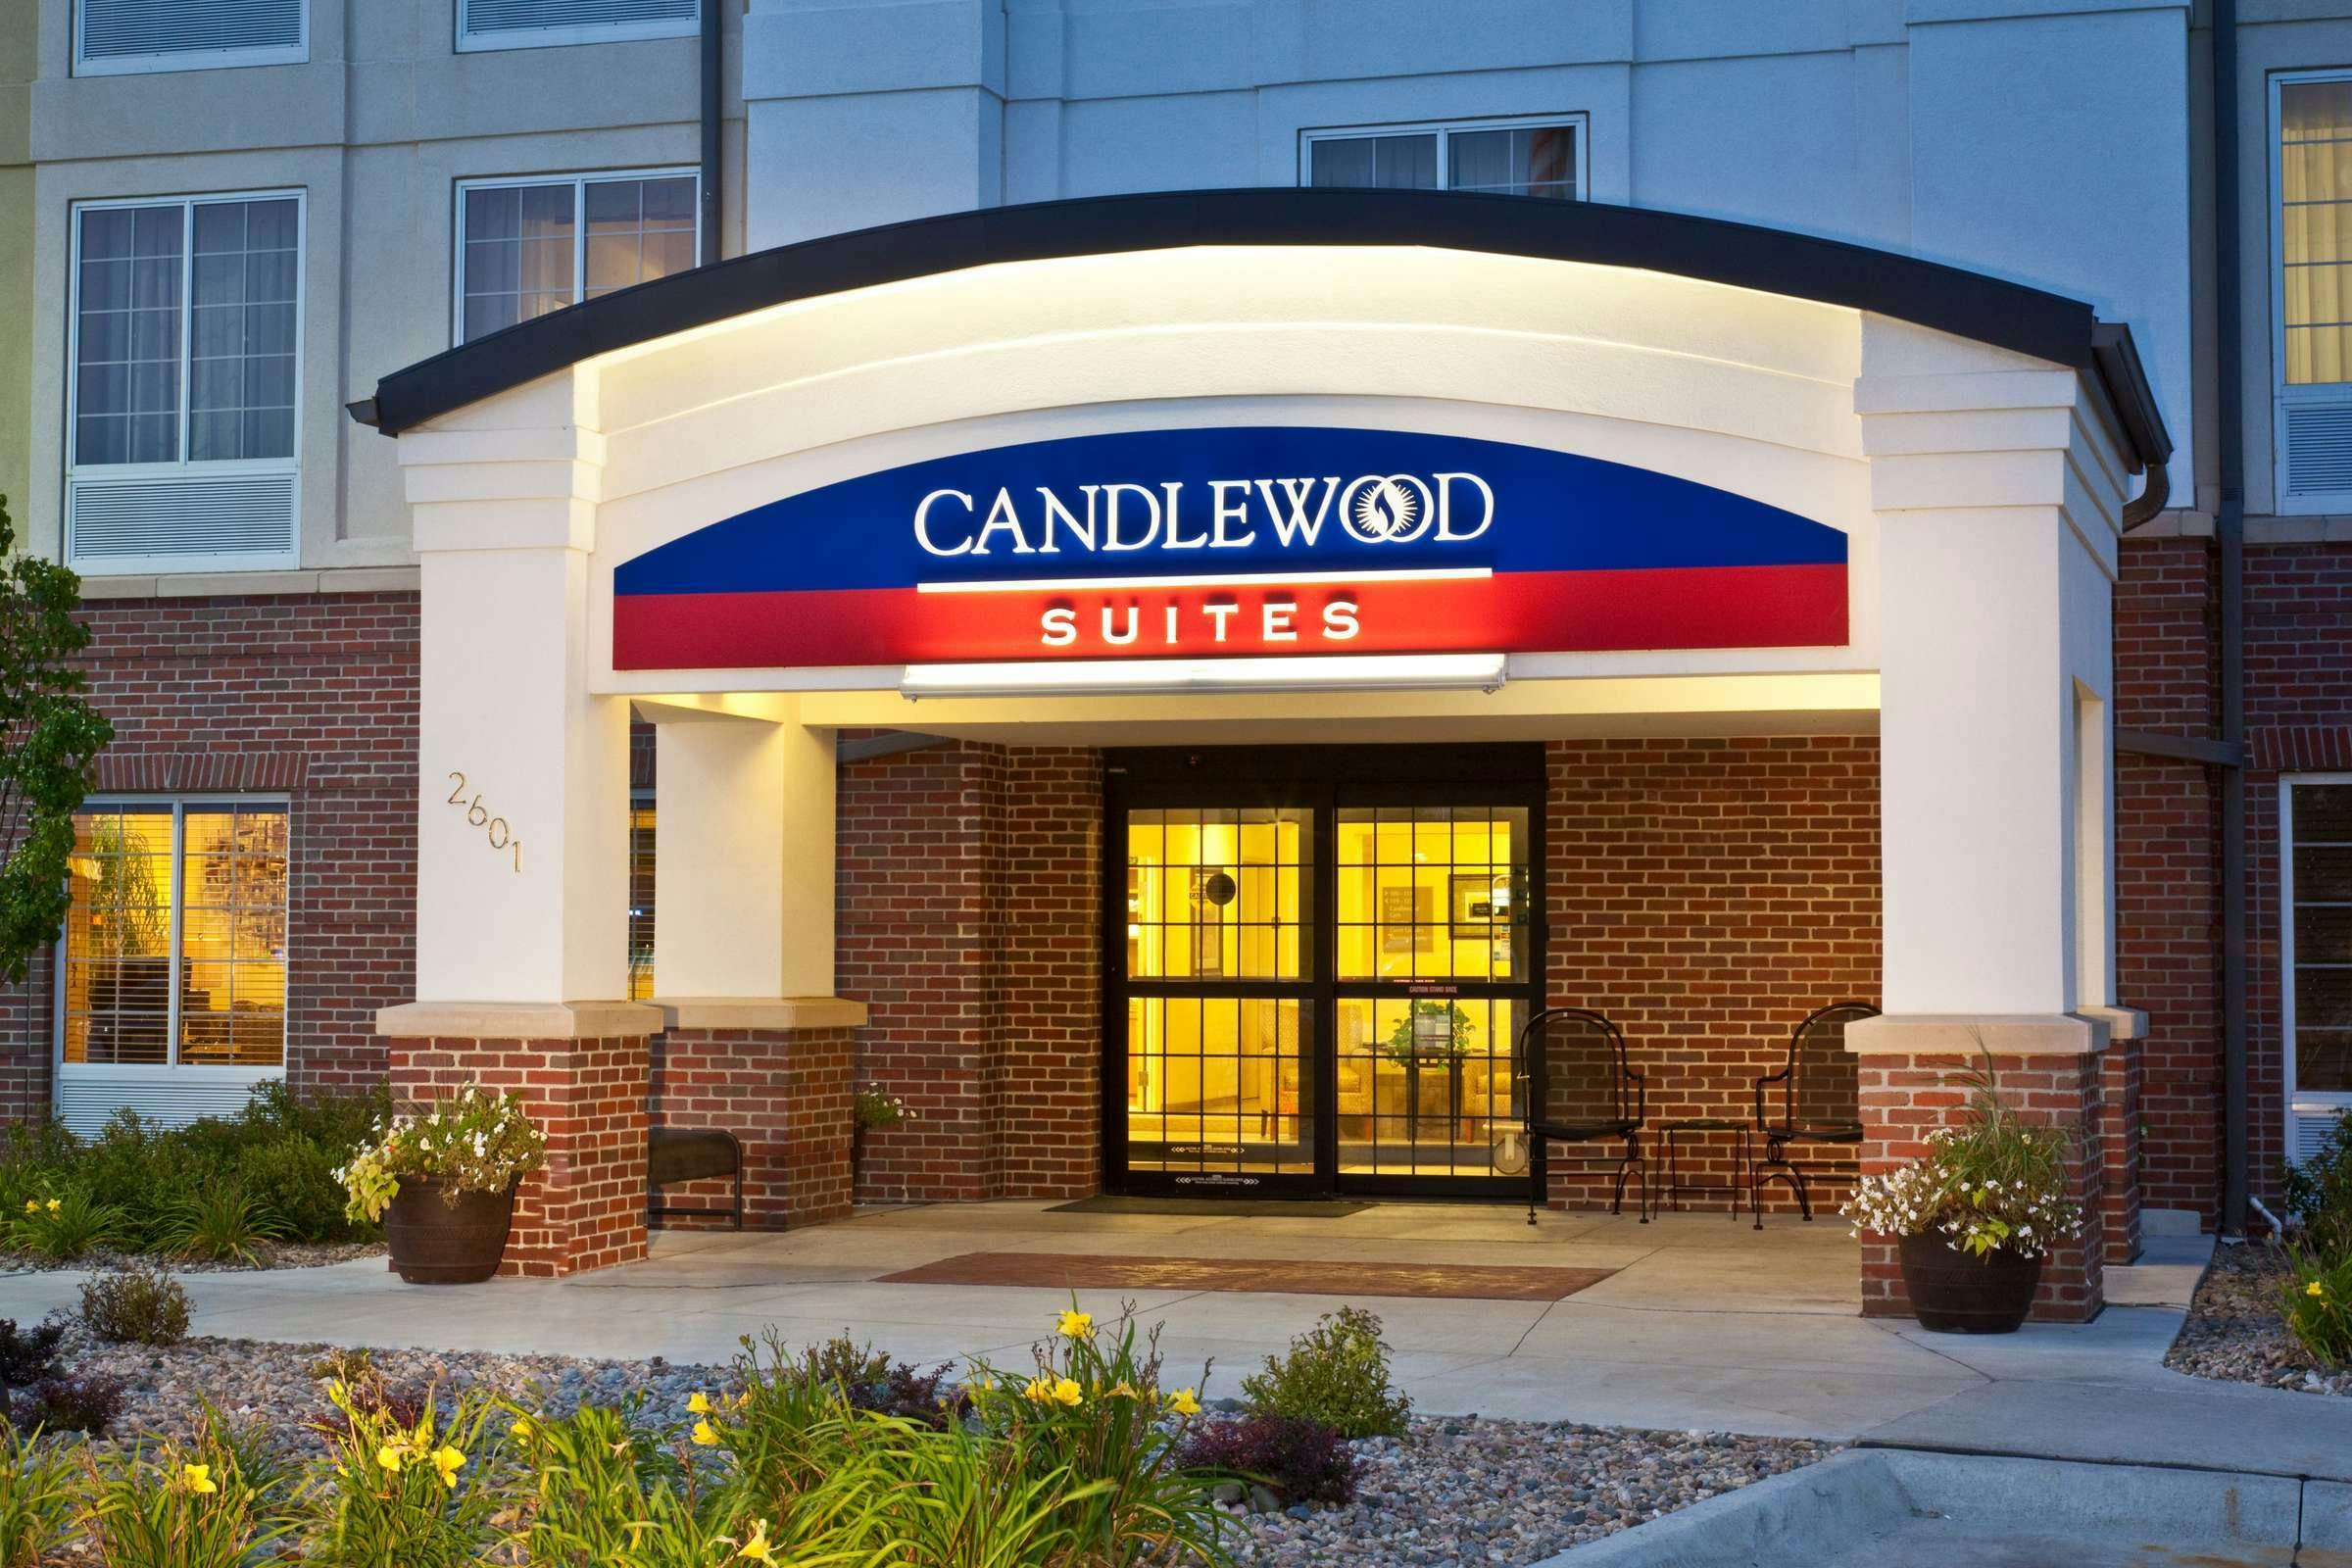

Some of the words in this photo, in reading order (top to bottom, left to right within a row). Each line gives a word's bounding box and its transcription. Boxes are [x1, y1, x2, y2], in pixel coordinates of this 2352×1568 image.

[913, 471, 1494, 557] CANDLEWOOD
[1041, 602, 1360, 646] SUITES
[448, 771, 520, 873] 2601
